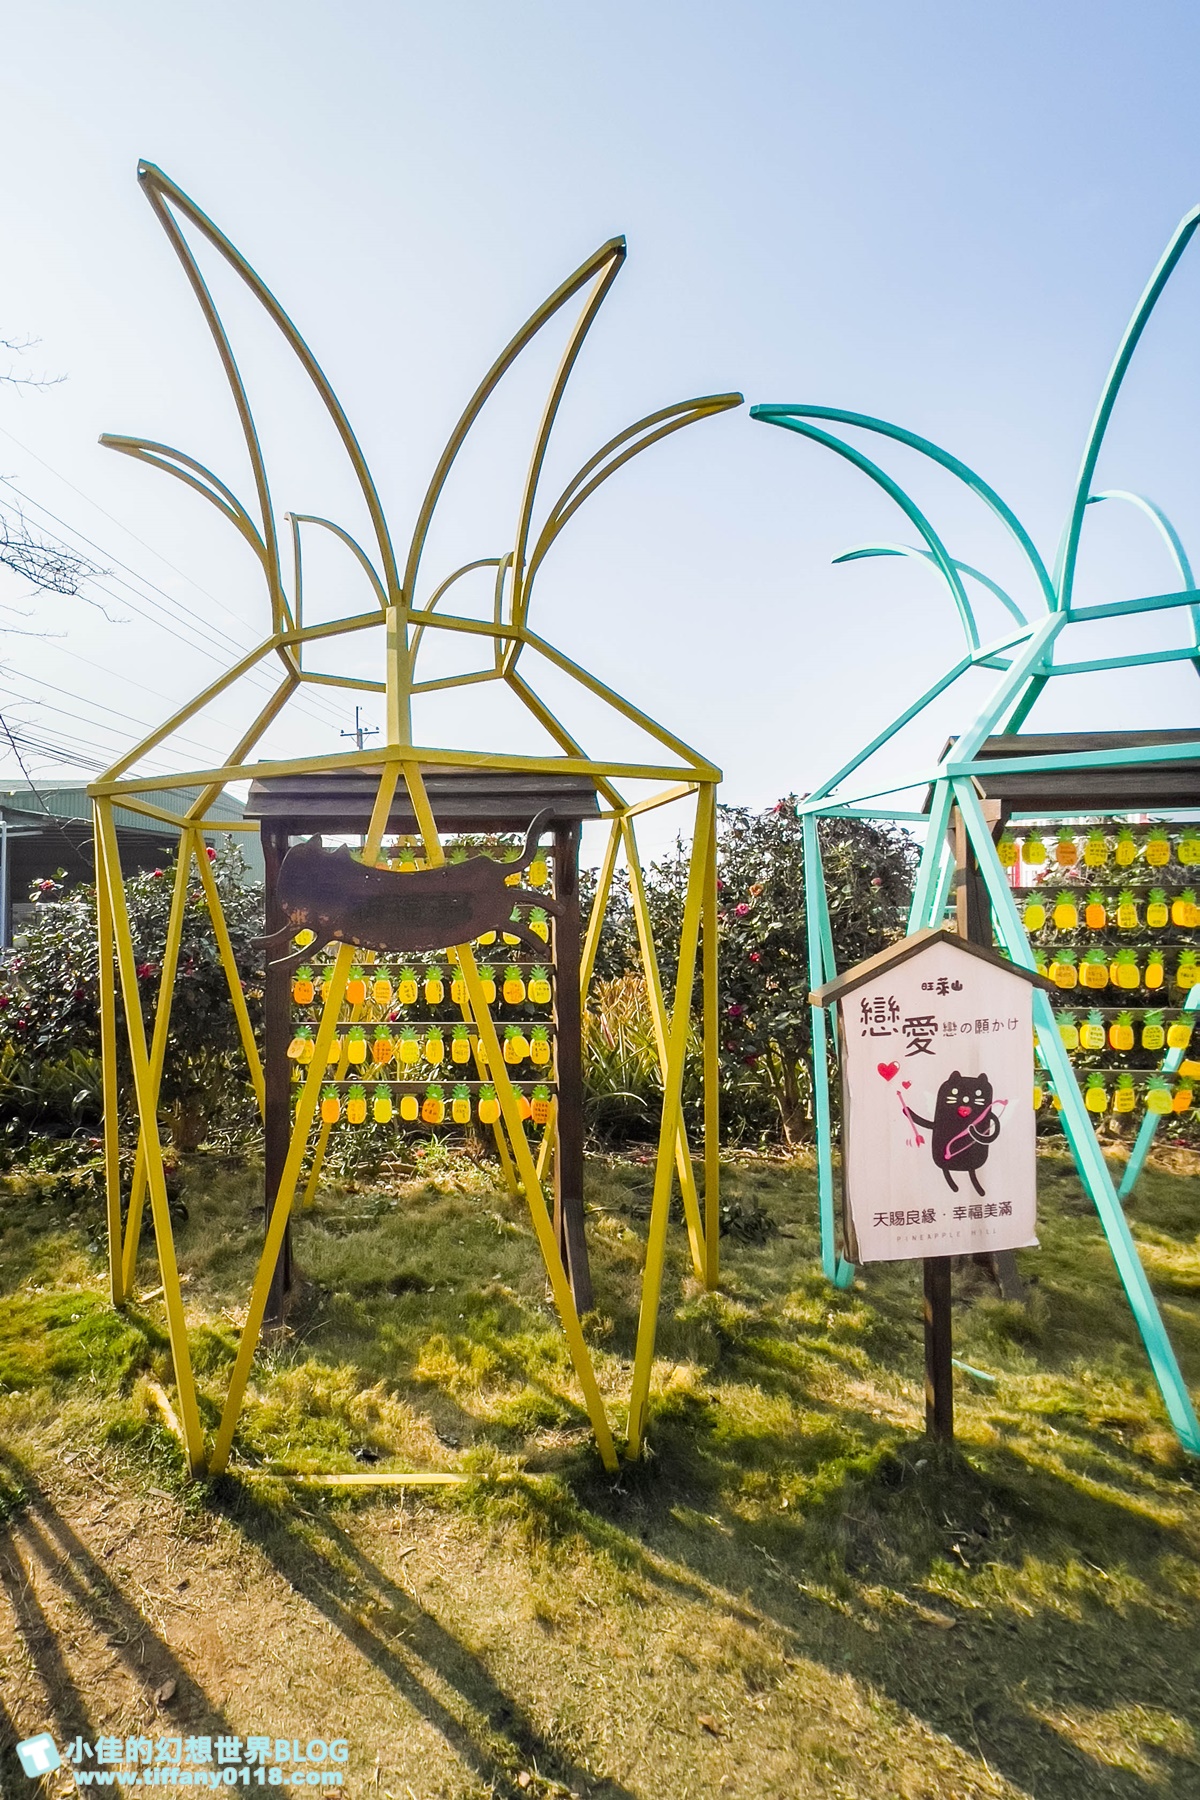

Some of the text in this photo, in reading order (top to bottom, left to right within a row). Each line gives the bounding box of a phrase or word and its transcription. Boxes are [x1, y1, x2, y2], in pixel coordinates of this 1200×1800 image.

[860, 995, 939, 1057] 戀愛
[896, 1228, 997, 1242] PINEAPPLE HILL
